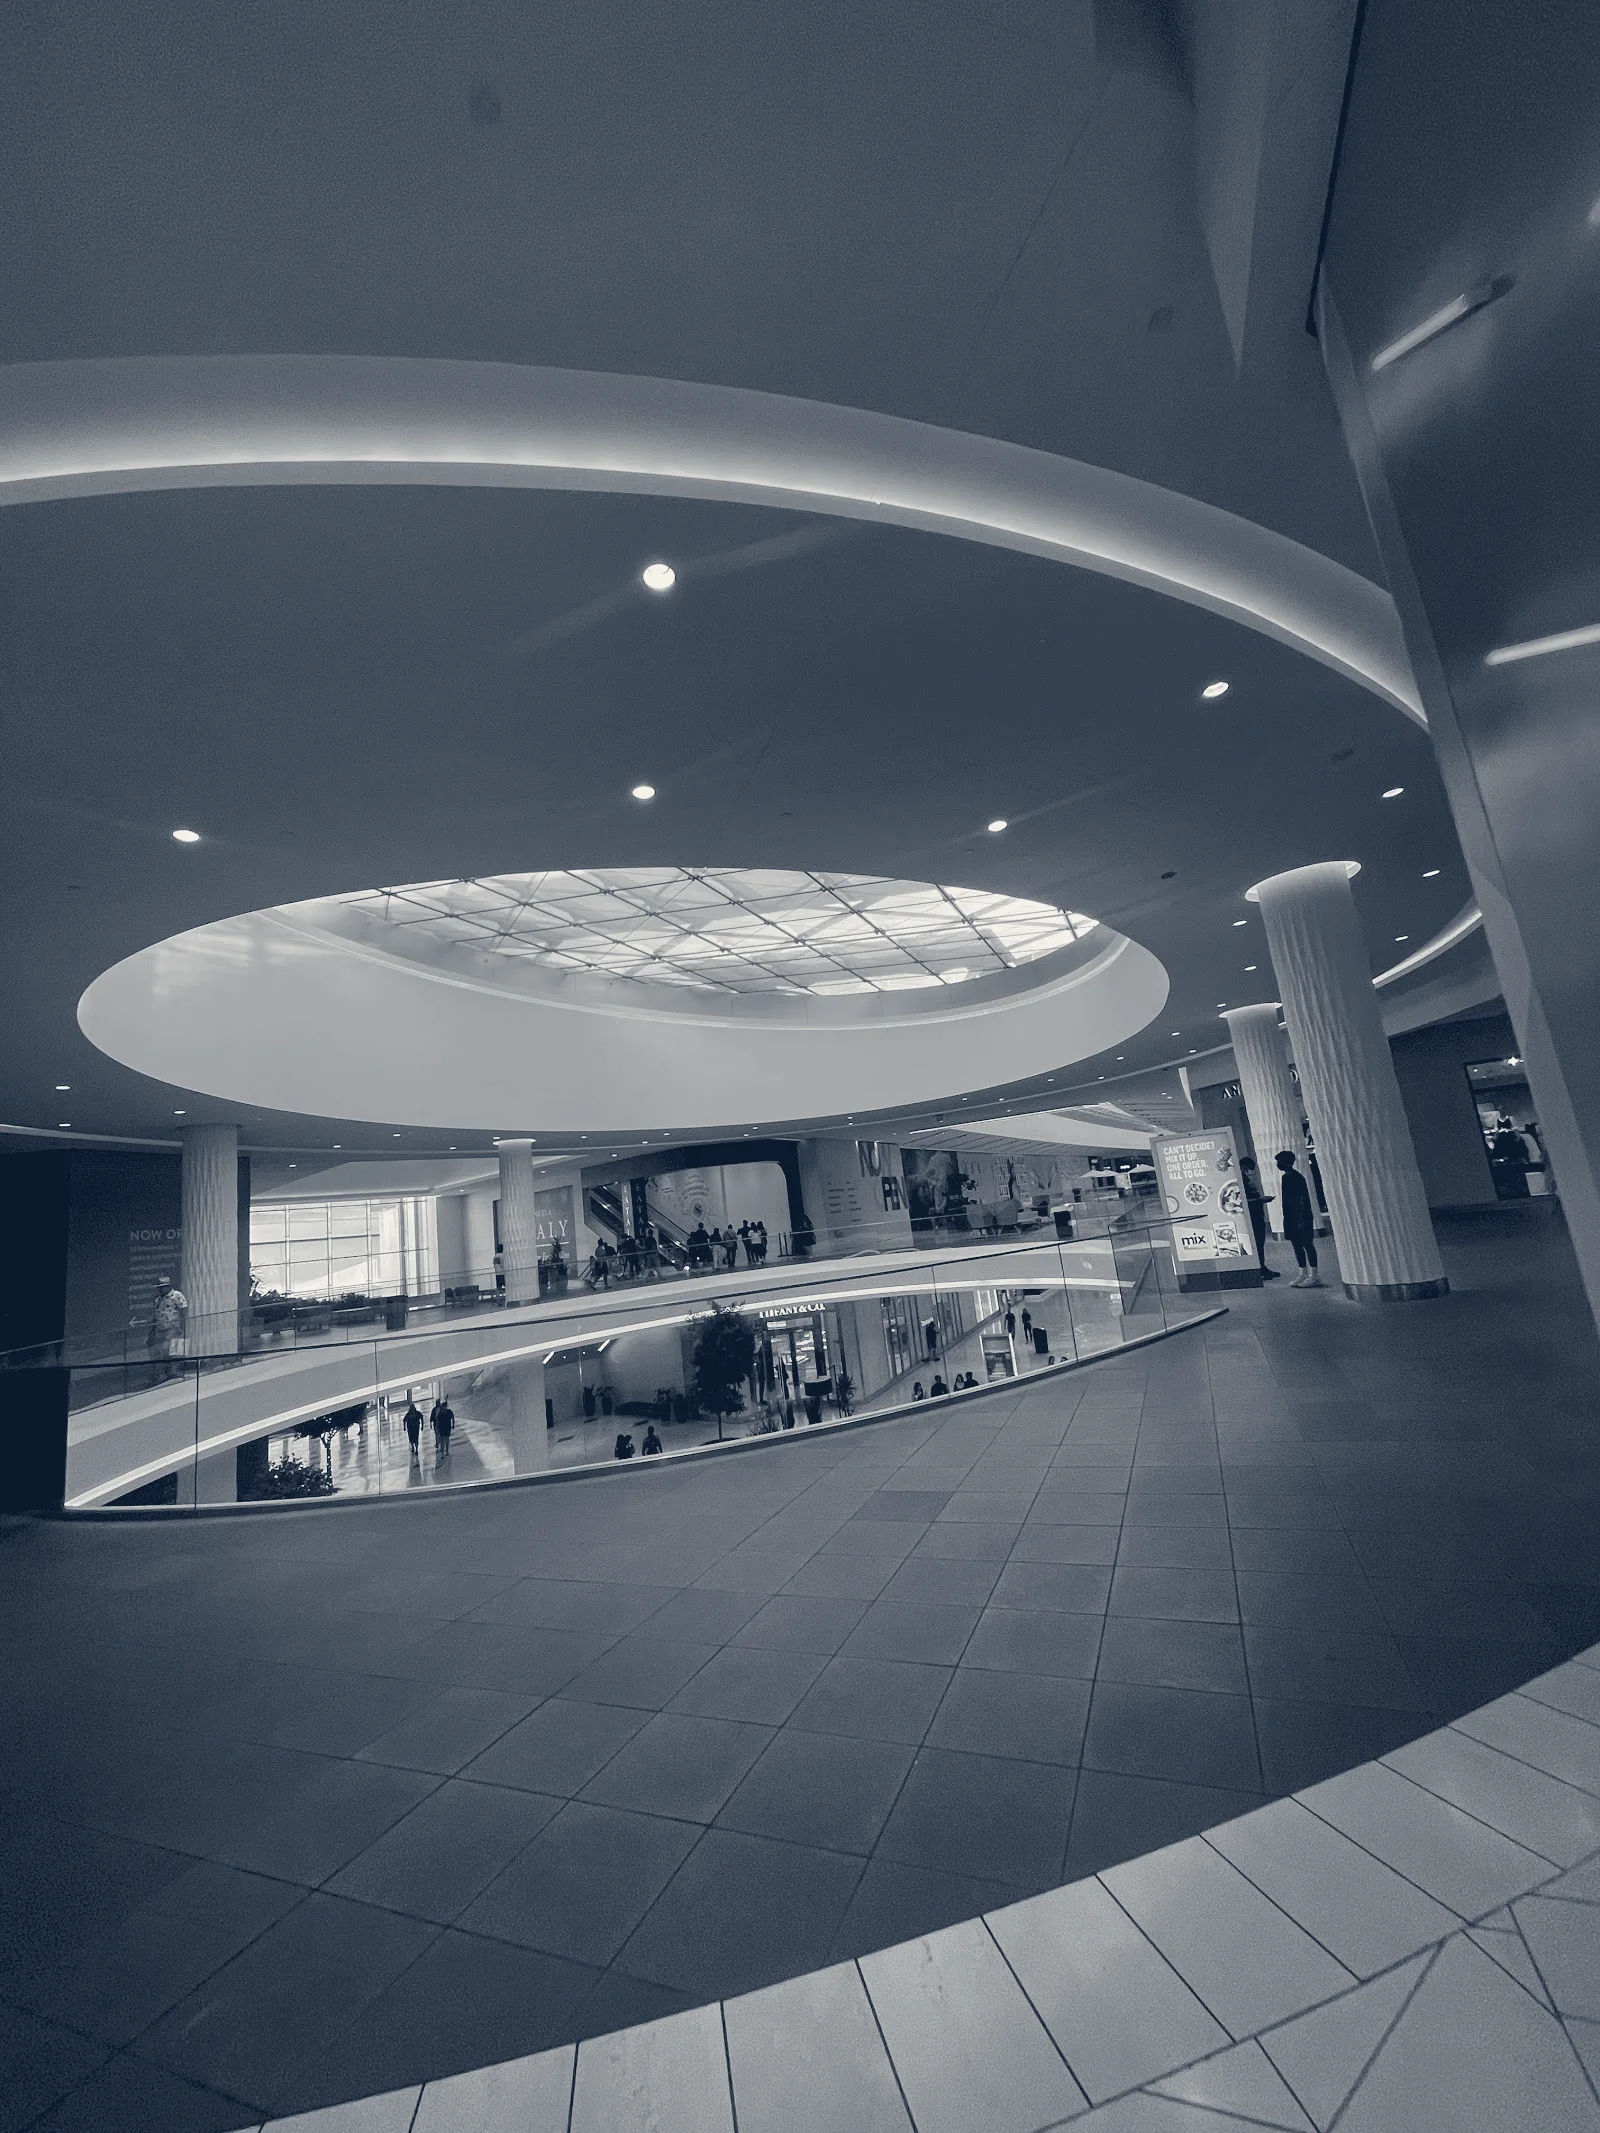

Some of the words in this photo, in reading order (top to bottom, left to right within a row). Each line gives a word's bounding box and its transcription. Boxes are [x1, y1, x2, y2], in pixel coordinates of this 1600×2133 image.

[1163, 1145, 1185, 1155] CAN'T
[1185, 1141, 1215, 1153] DECIDE?
[1165, 1155, 1179, 1164] MIX
[1179, 1153, 1186, 1162] IT
[1167, 1162, 1182, 1172] ONE
[1182, 1160, 1209, 1170] ORDER.
[1169, 1171, 1183, 1180] ALL
[1183, 1170, 1193, 1179] TO
[1194, 1169, 1207, 1178] GO.
[130, 1229, 162, 1241] NOW
[536, 1219, 568, 1240] ALY
[1181, 1232, 1206, 1246] mix
